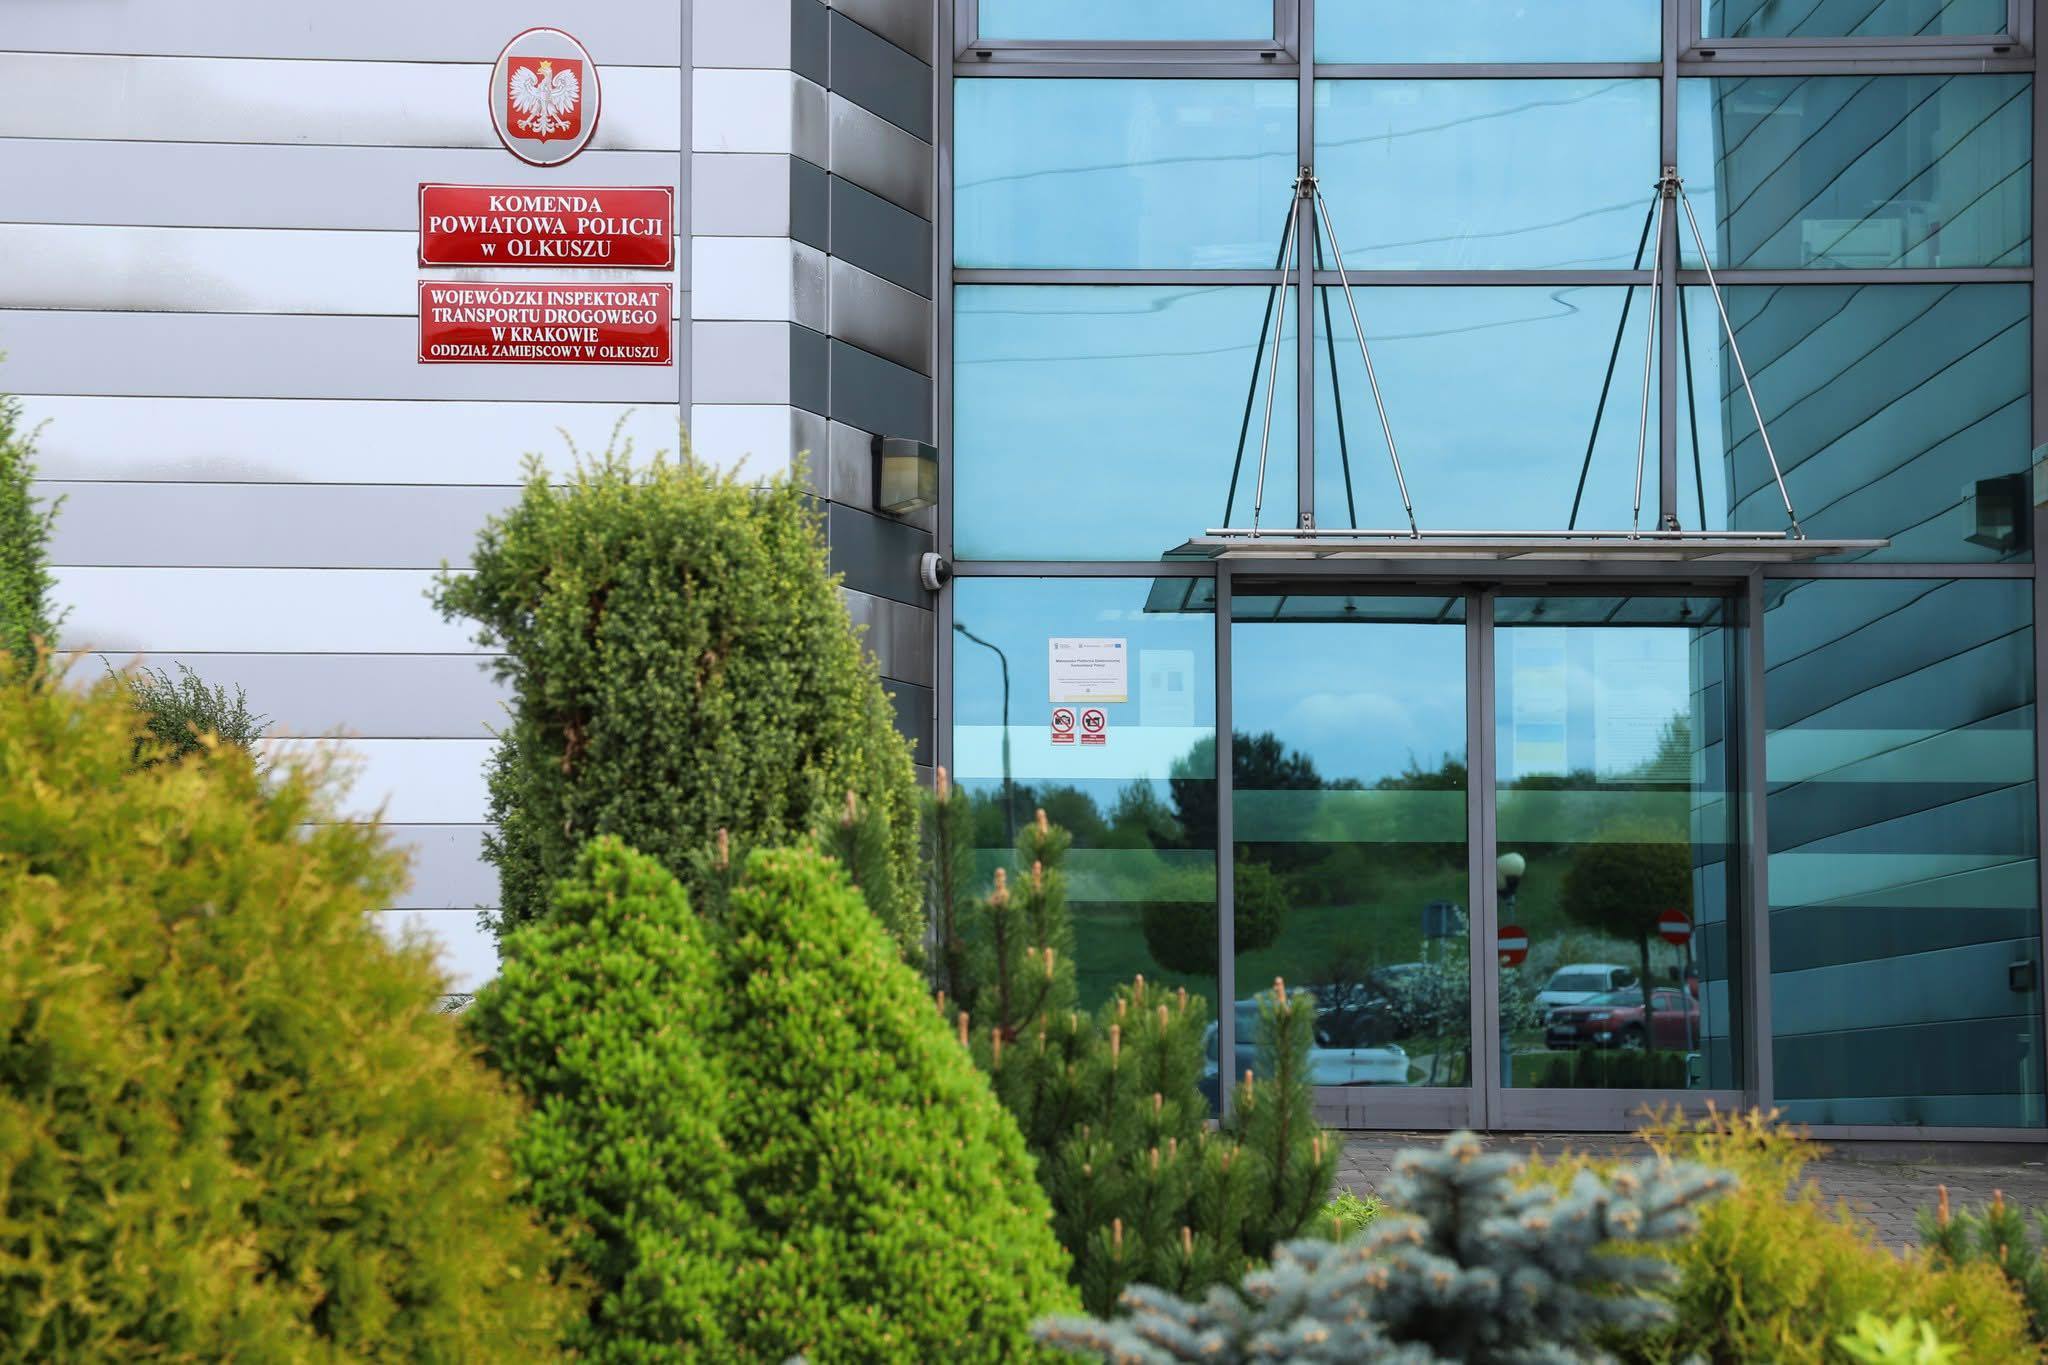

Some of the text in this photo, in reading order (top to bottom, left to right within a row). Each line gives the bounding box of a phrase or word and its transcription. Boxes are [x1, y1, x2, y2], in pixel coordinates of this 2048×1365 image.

[489, 196, 602, 212] KOMENDA
[430, 216, 662, 235] POWIATOWA POLICJI
[508, 239, 611, 257] OLKUSZU
[431, 288, 659, 306] WOJEWÓDZKI INSPEKTORAT
[432, 308, 657, 324] TRANSPORTU DROGOWEGO
[491, 327, 598, 342] W KRAKOWIE
[431, 345, 658, 358] ODDZIAŁ ZAMIEJSCOWY W OLKUSZU
